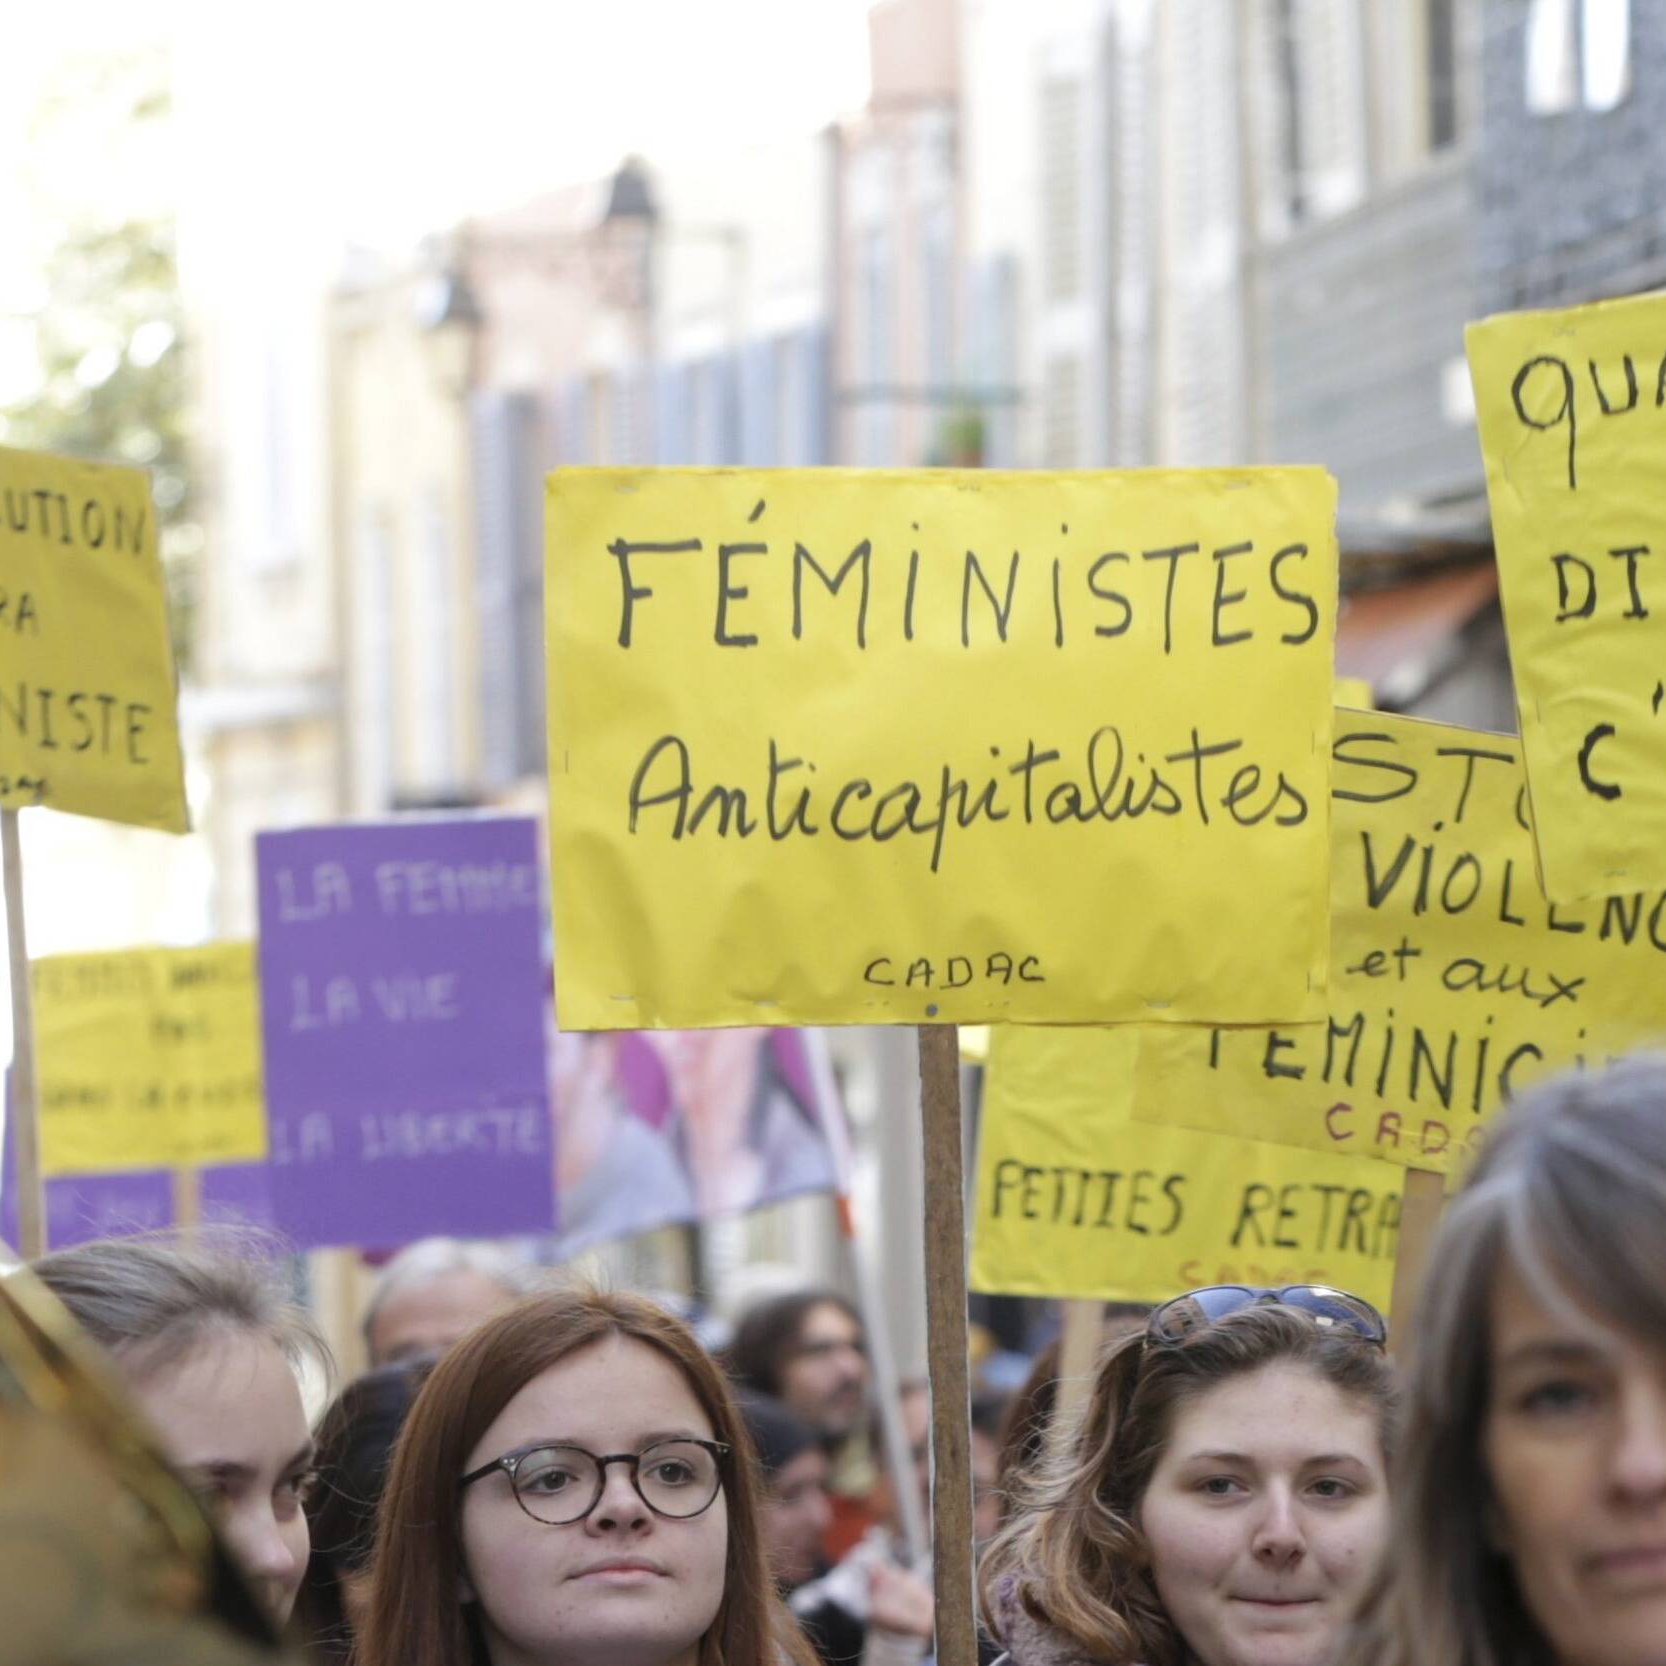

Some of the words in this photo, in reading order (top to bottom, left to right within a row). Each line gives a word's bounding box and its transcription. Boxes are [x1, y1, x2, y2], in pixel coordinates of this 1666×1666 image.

[628, 725, 1310, 873] Anticapitalistes
[1331, 732, 1530, 831] ST
[863, 951, 1047, 990] CADAC
[1344, 936, 1423, 982] et
[1440, 955, 1588, 1009] aux
